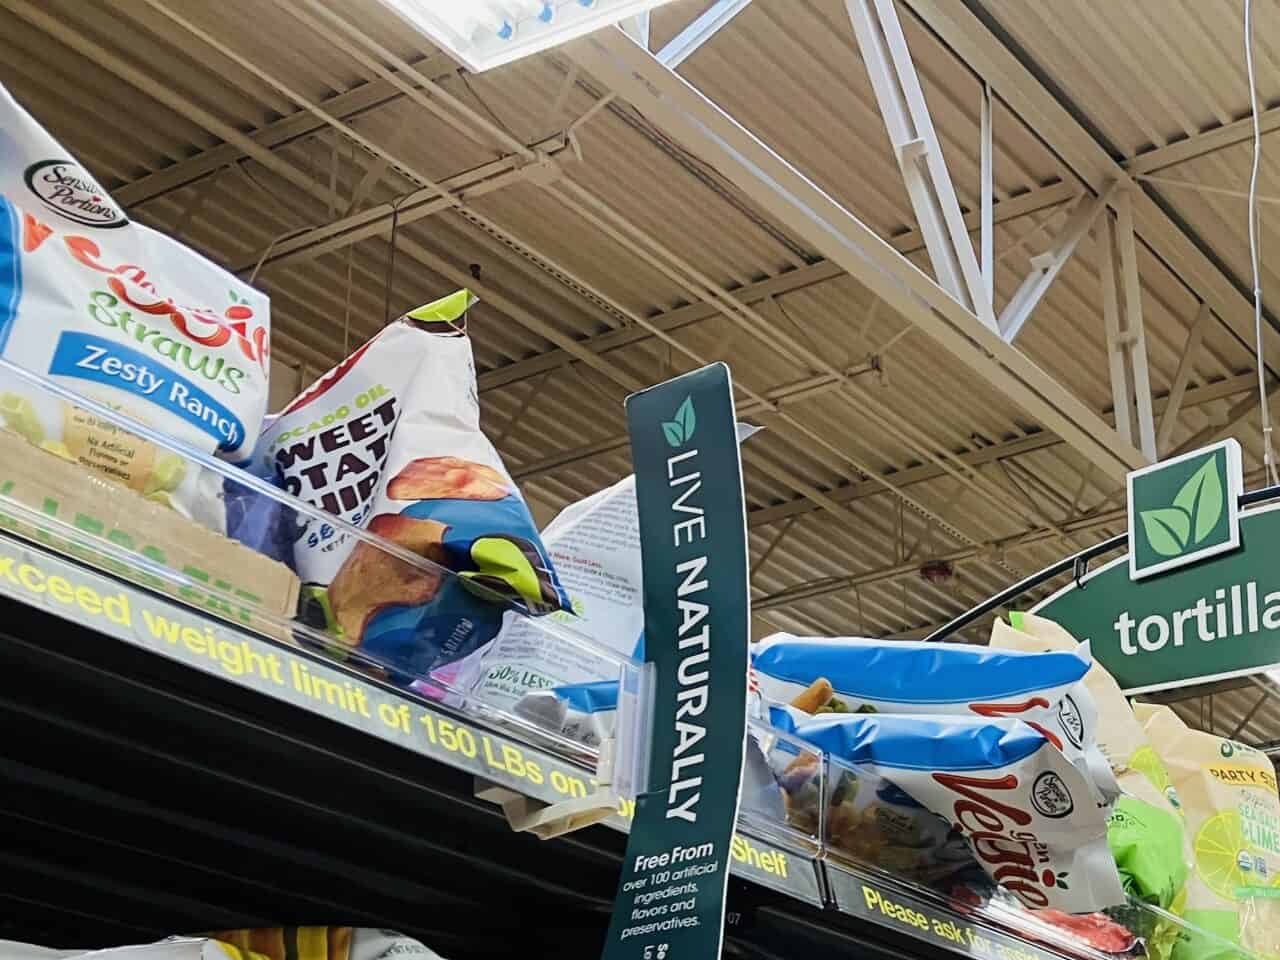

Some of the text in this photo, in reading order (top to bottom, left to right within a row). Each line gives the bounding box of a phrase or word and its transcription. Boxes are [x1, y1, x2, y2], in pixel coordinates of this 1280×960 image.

[48, 185, 117, 221] Portions
[89, 290, 247, 395] Straws
[77, 345, 165, 394] Zesty
[168, 381, 241, 446] Ranch
[276, 397, 396, 469] WEET
[282, 433, 390, 497] OTAT
[308, 471, 380, 515] HIP
[667, 449, 707, 548] LIVE
[0, 555, 789, 879] xceed weight limit of 150 LBs on Shelf
[666, 556, 711, 823] NATURALLY
[623, 861, 719, 892] over 100 artificial
[634, 842, 715, 873] Free From
[620, 915, 701, 940] preservatives.
[631, 897, 696, 921] flavors and
[862, 885, 929, 933] Please
[932, 917, 966, 944] ask
[968, 927, 993, 954] for
